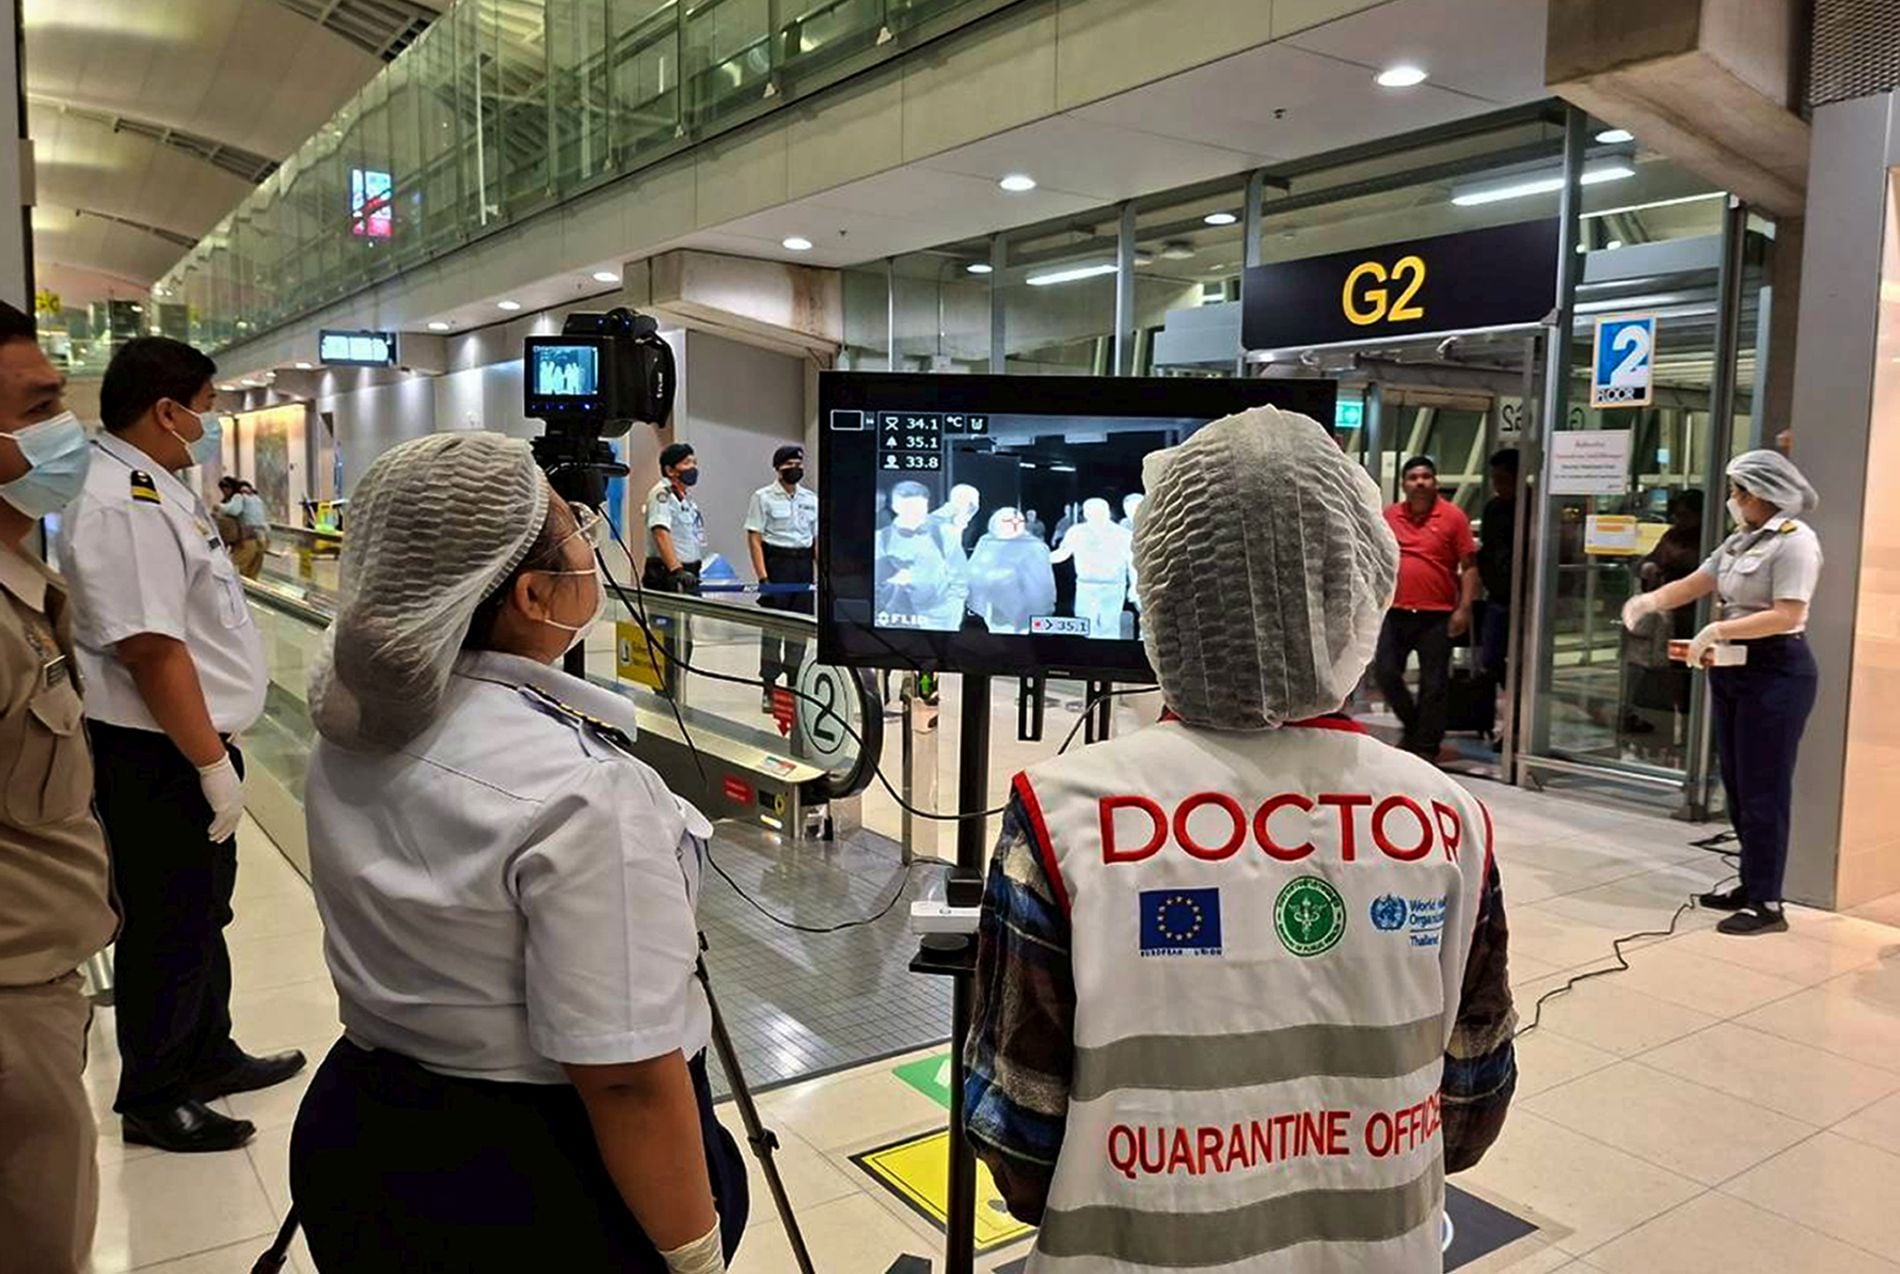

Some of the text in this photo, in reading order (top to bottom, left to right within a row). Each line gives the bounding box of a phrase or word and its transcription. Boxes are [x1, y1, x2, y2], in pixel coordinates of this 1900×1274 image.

[1342, 255, 1426, 326] G2
[1611, 325, 1650, 387] 2
[905, 418, 938, 430] 34.1
[905, 436, 938, 448] 35.1
[905, 456, 939, 468] 33.8
[1057, 619, 1087, 632] 35.1
[812, 672, 836, 743] 2
[1098, 791, 1461, 864] DOCTOR
[1107, 1110, 1351, 1179] QUARANTINE
